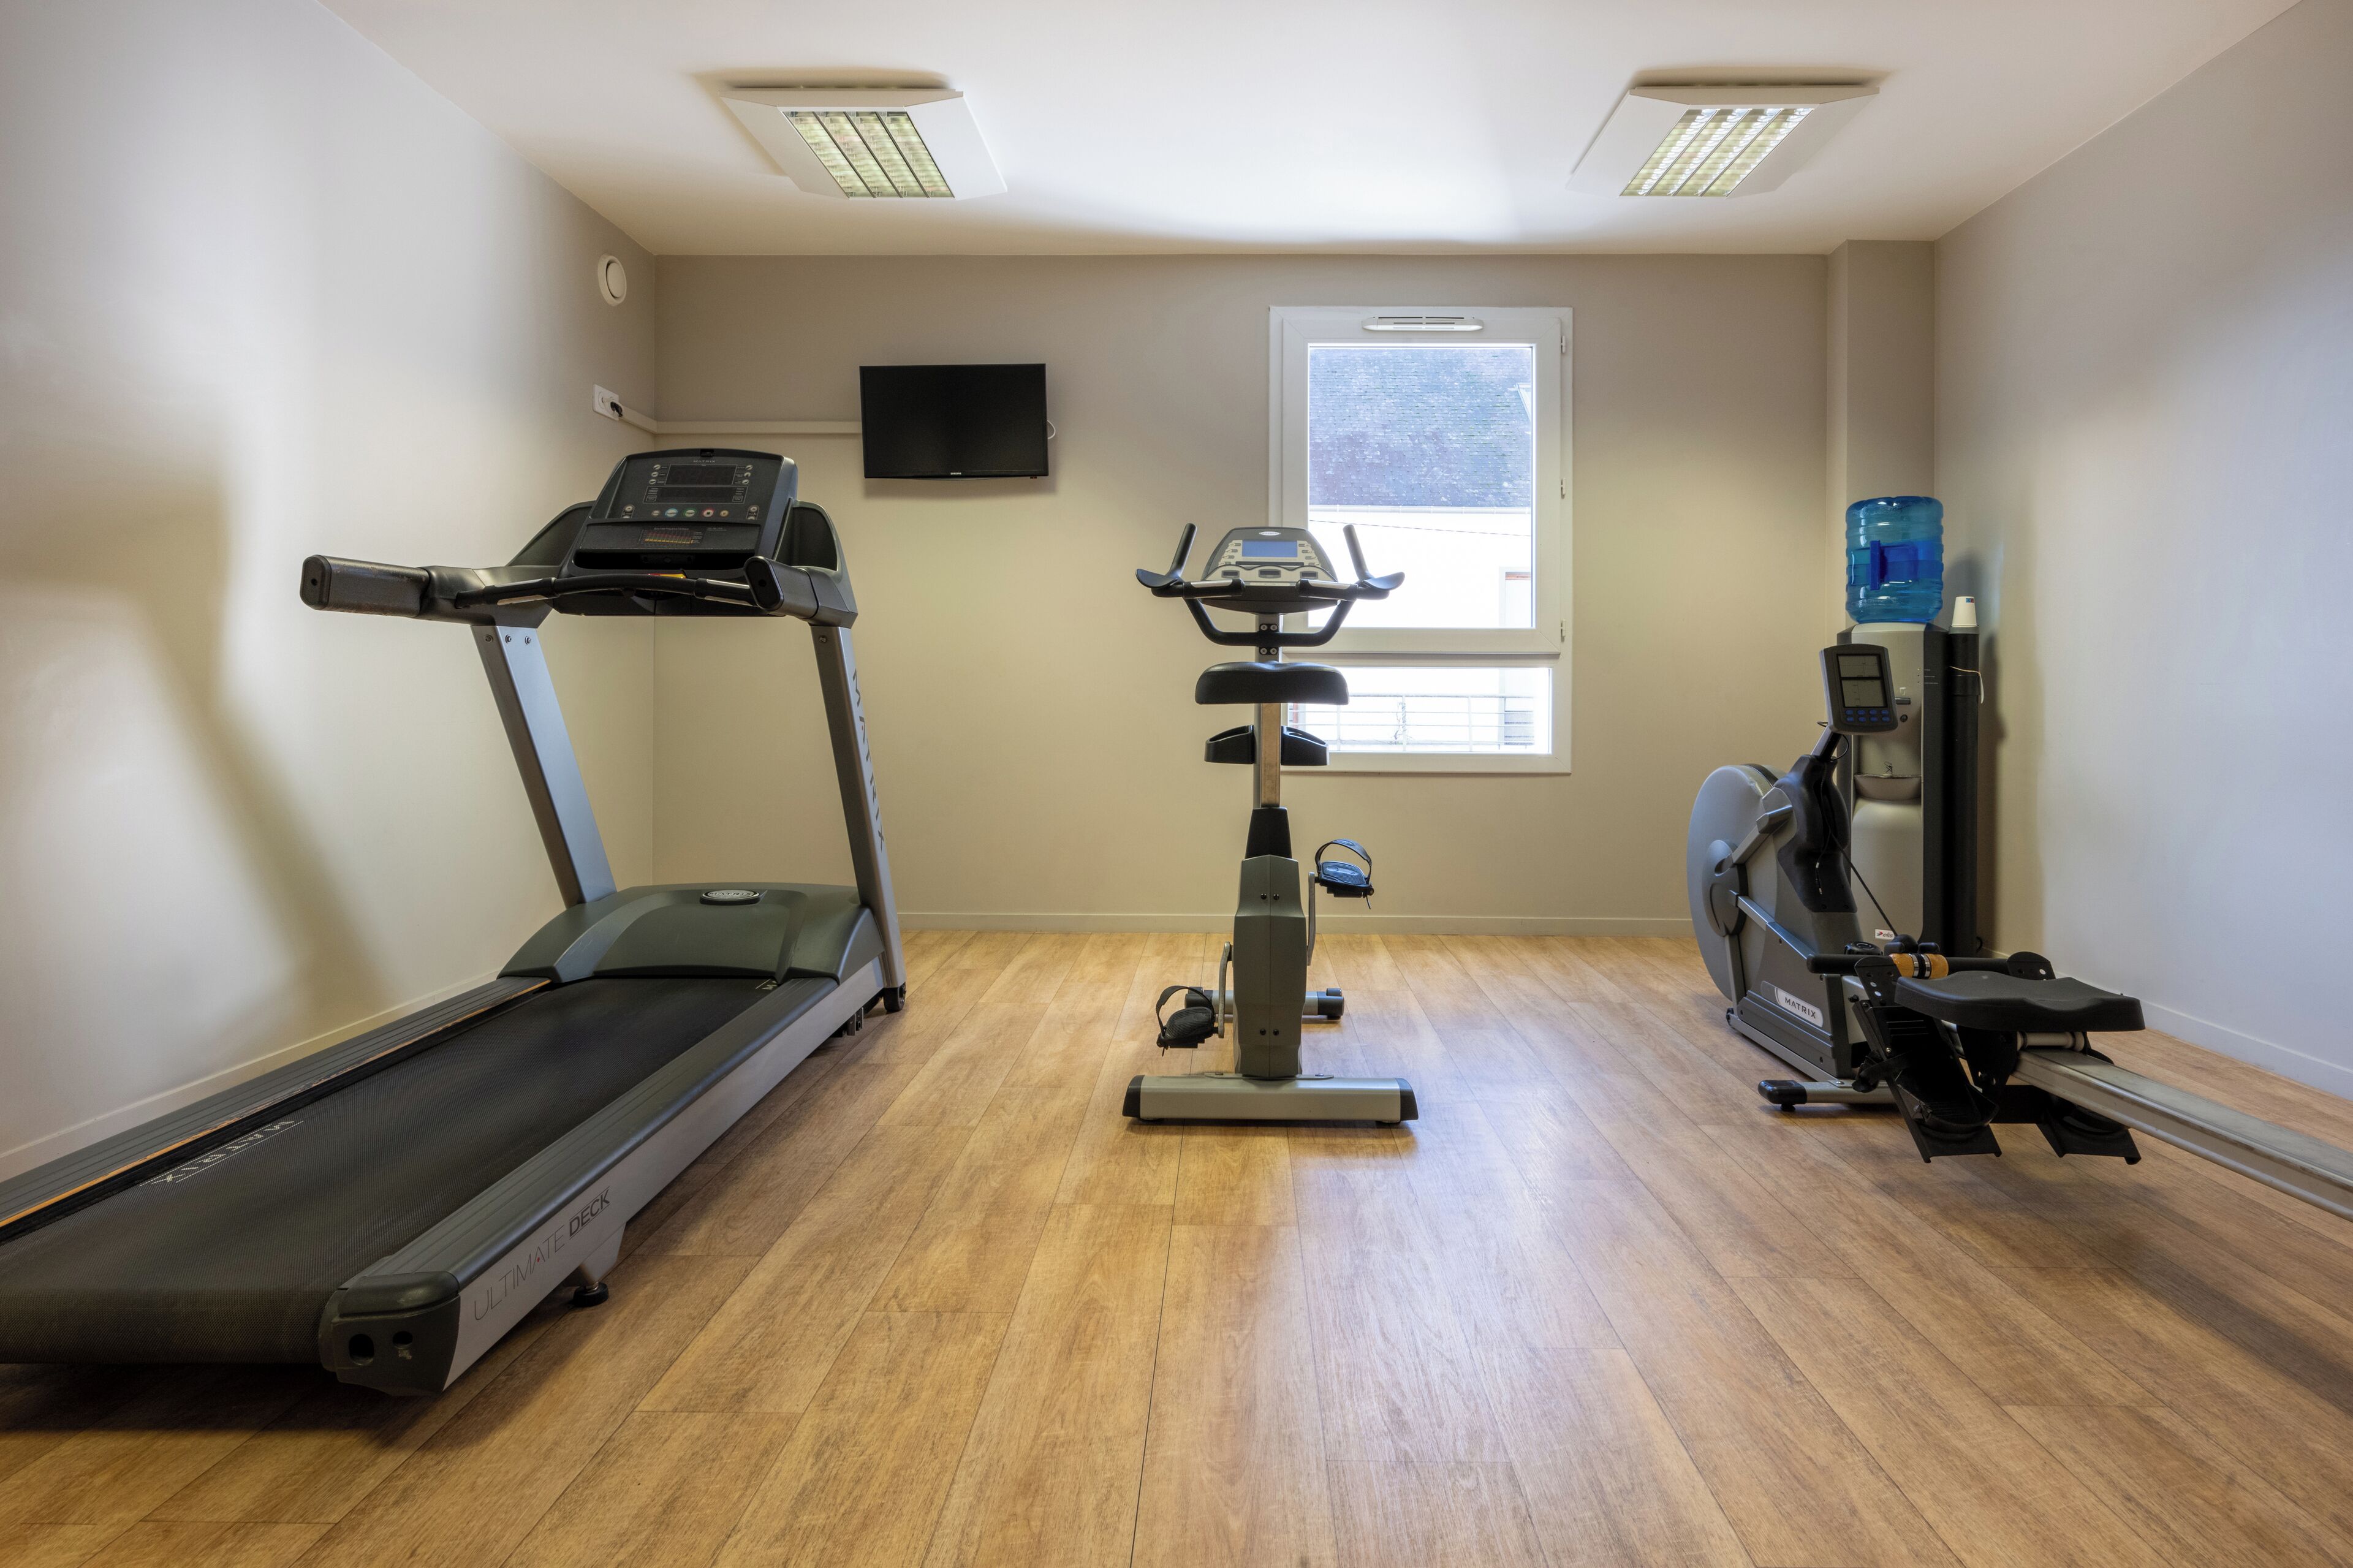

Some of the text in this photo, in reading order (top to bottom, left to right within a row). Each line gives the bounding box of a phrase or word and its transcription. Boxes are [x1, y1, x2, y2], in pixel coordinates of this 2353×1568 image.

[852, 668, 884, 854] MATRIX
[1784, 996, 1816, 1019] MATRIX
[474, 1187, 611, 1321] ULTIMATE DECK
